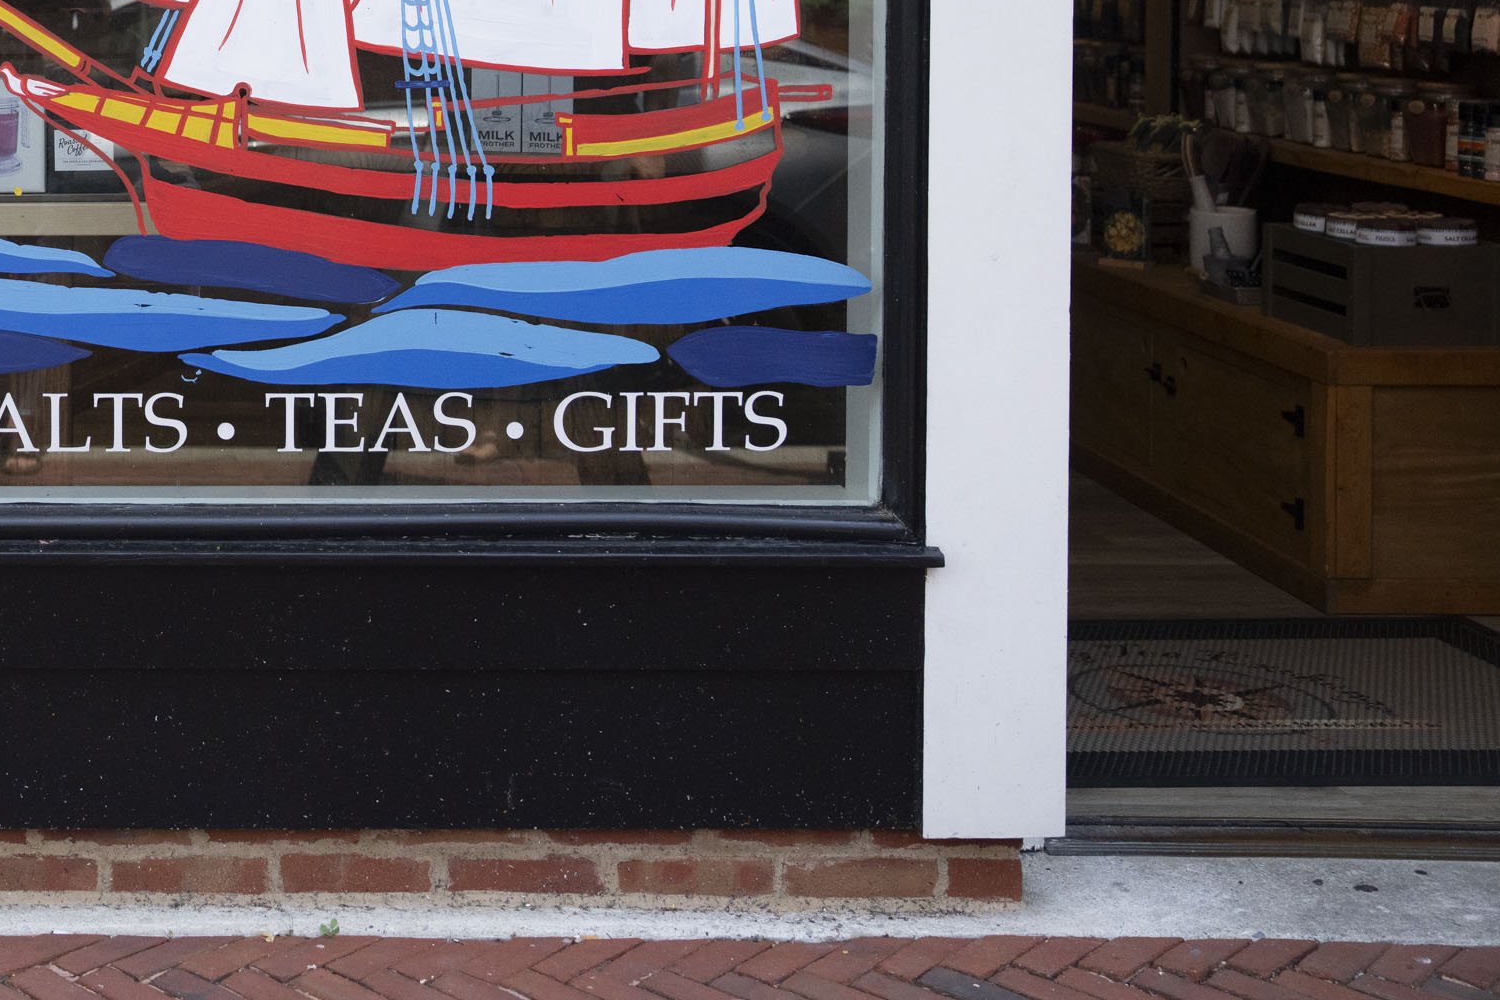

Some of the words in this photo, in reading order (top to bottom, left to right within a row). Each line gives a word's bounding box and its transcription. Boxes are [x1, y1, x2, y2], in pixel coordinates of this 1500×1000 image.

[58, 133, 88, 149] Roas
[478, 130, 515, 141] MILK
[67, 144, 90, 157] Coffe
[266, 391, 477, 453] TEAS
[553, 391, 788, 452] GIFTS
